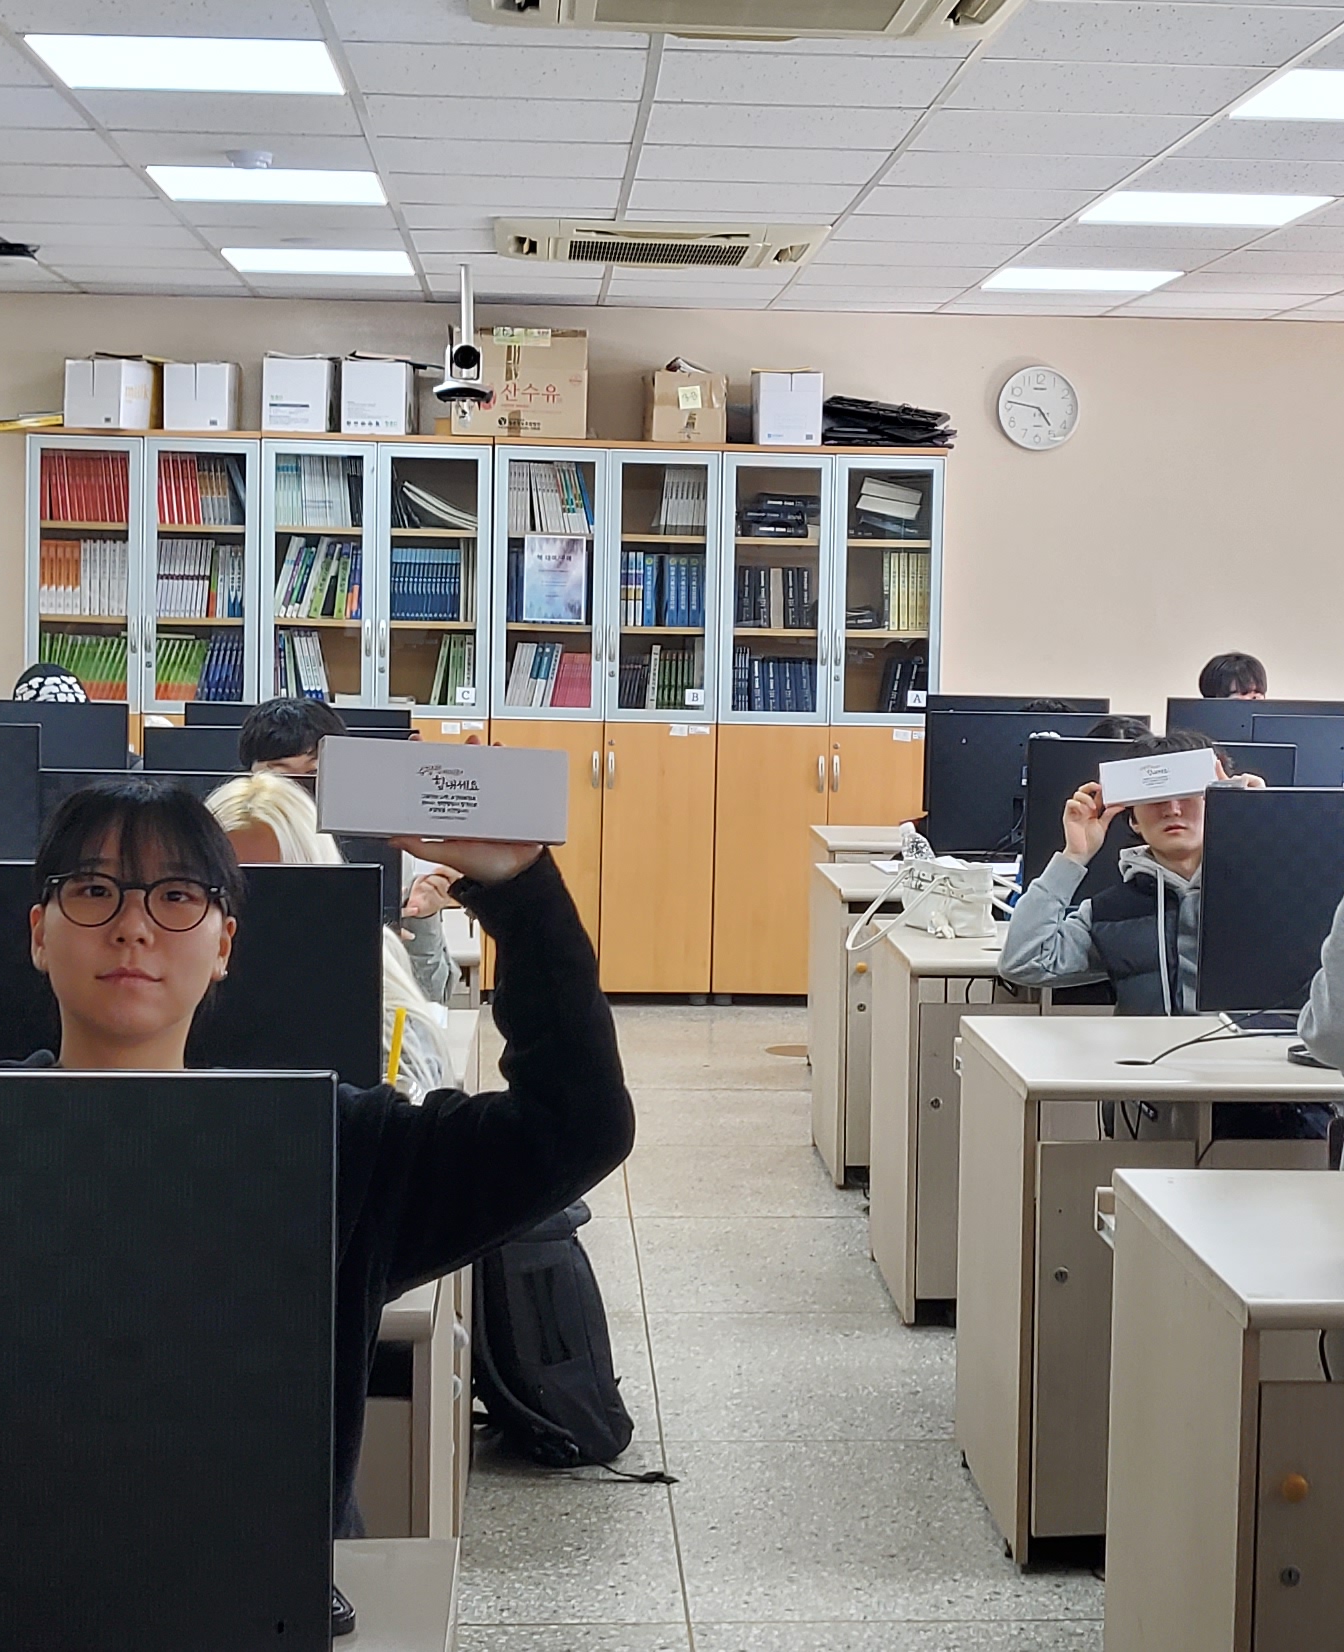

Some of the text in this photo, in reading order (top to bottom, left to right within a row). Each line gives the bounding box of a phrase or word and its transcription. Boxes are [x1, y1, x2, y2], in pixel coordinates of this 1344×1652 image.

[1023, 375, 1031, 387] 11
[1036, 373, 1046, 385] 12
[501, 383, 561, 404] 산수유
[1011, 386, 1023, 398] 10
[1061, 388, 1070, 400] 2
[1005, 401, 1013, 412] 9
[1065, 404, 1074, 416] 3
[1008, 417, 1017, 429] 8
[1060, 419, 1068, 430] 4
[1021, 428, 1029, 439] 7
[1033, 432, 1042, 444] 6
[1048, 430, 1056, 439] 5
[461, 690, 470, 700] C
[691, 692, 699, 702] B
[912, 694, 922, 704] A
[432, 775, 480, 790] 힘내세요
